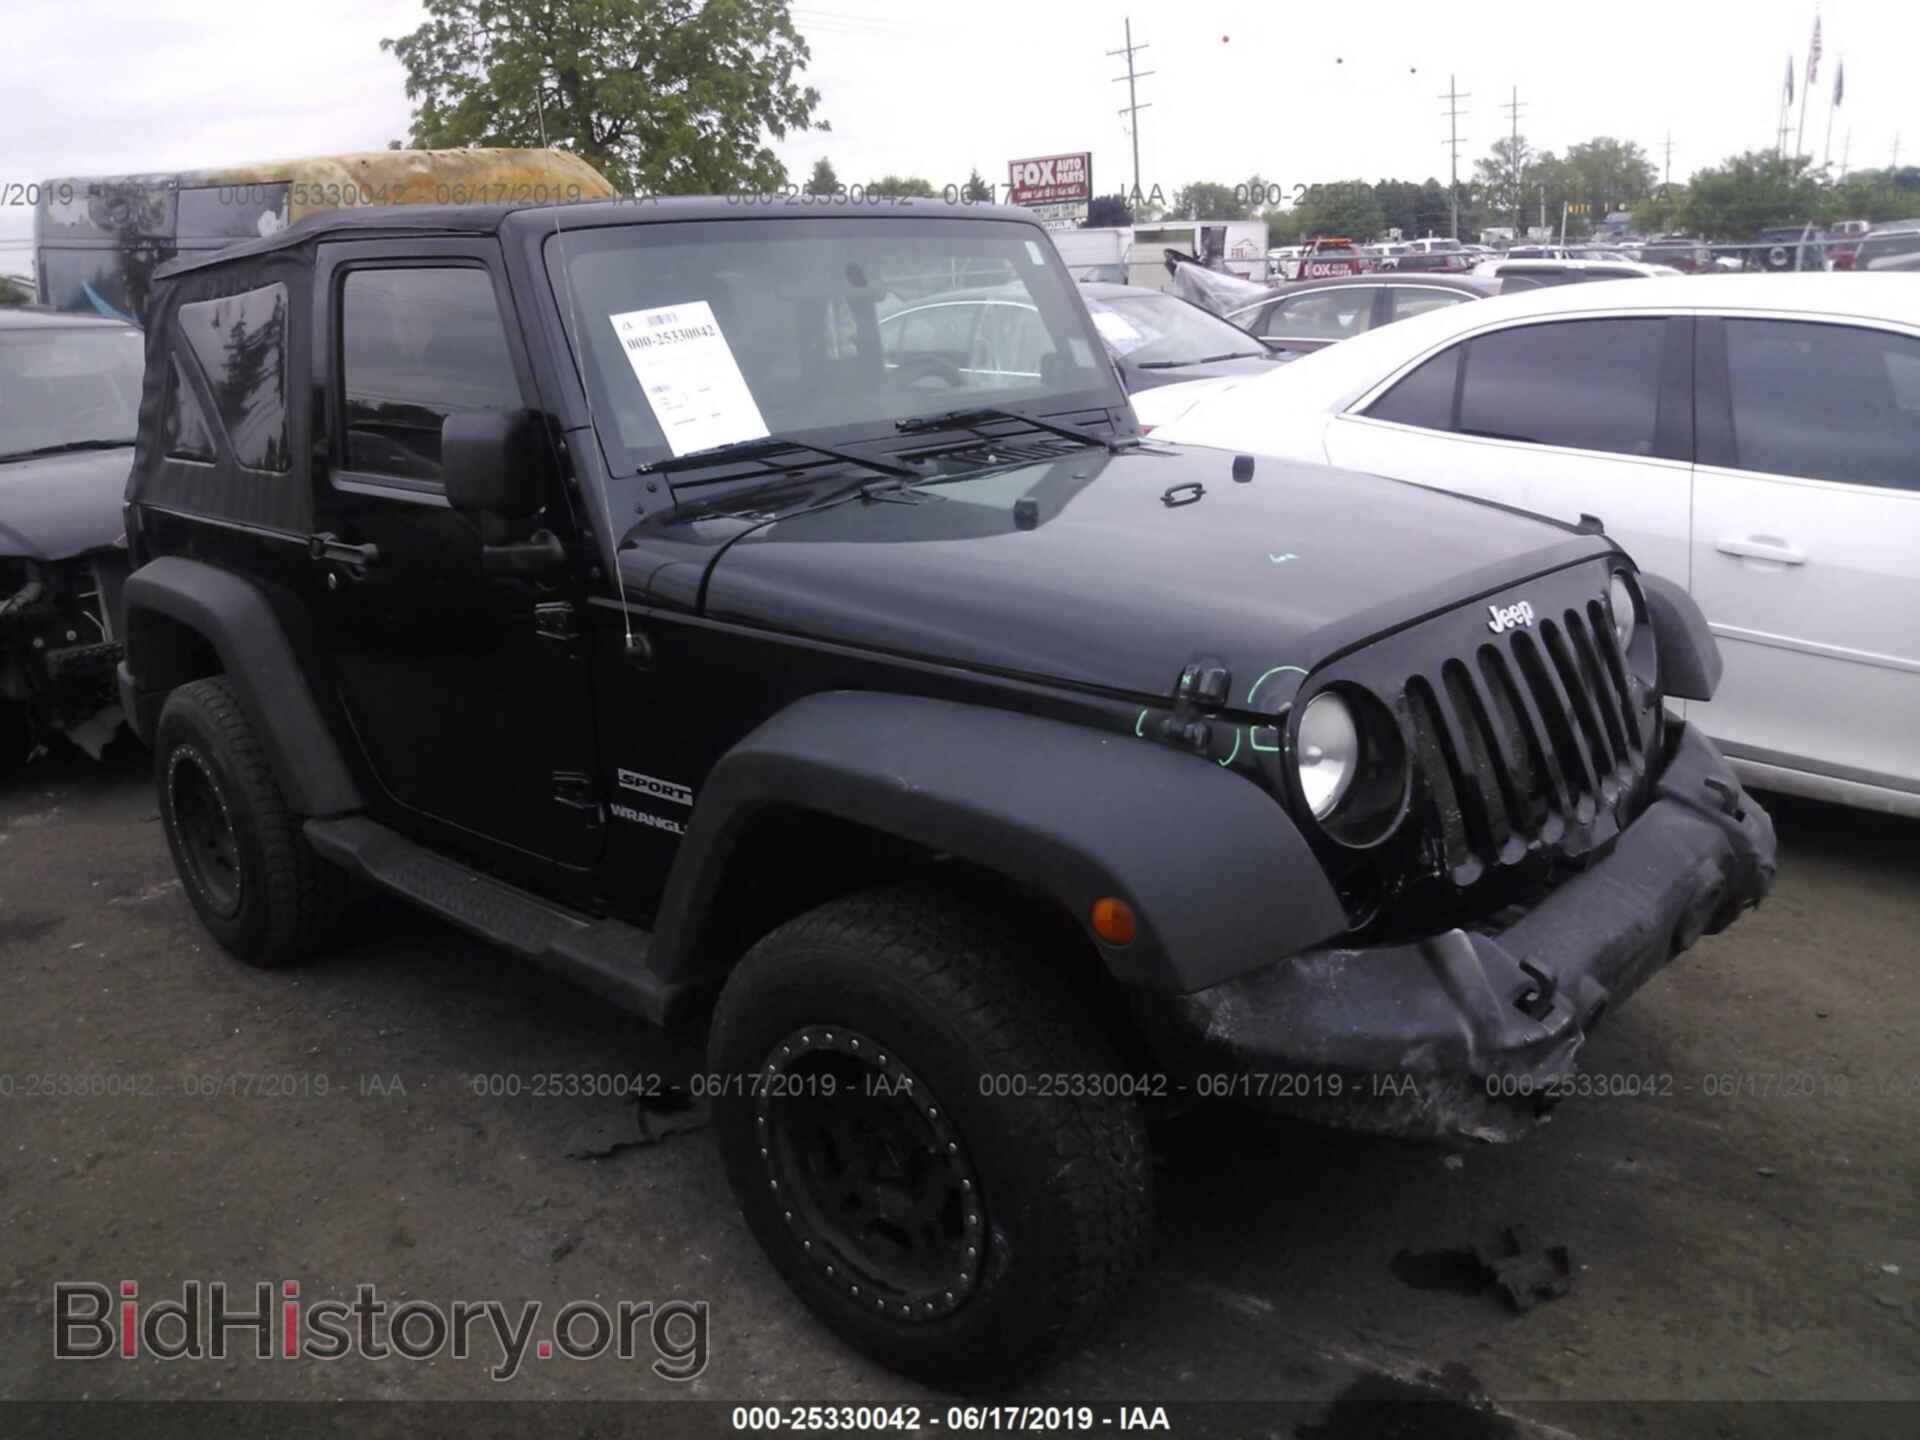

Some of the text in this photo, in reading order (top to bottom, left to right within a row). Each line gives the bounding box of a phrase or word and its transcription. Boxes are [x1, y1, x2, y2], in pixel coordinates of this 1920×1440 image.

[1012, 157, 1081, 188] FOX AUTO
[1056, 169, 1084, 185] PARTS
[626, 324, 717, 350] 000-25330042
[1488, 601, 1533, 633] Jeep
[621, 772, 693, 801] SPORT
[610, 802, 688, 835] WRANGL
